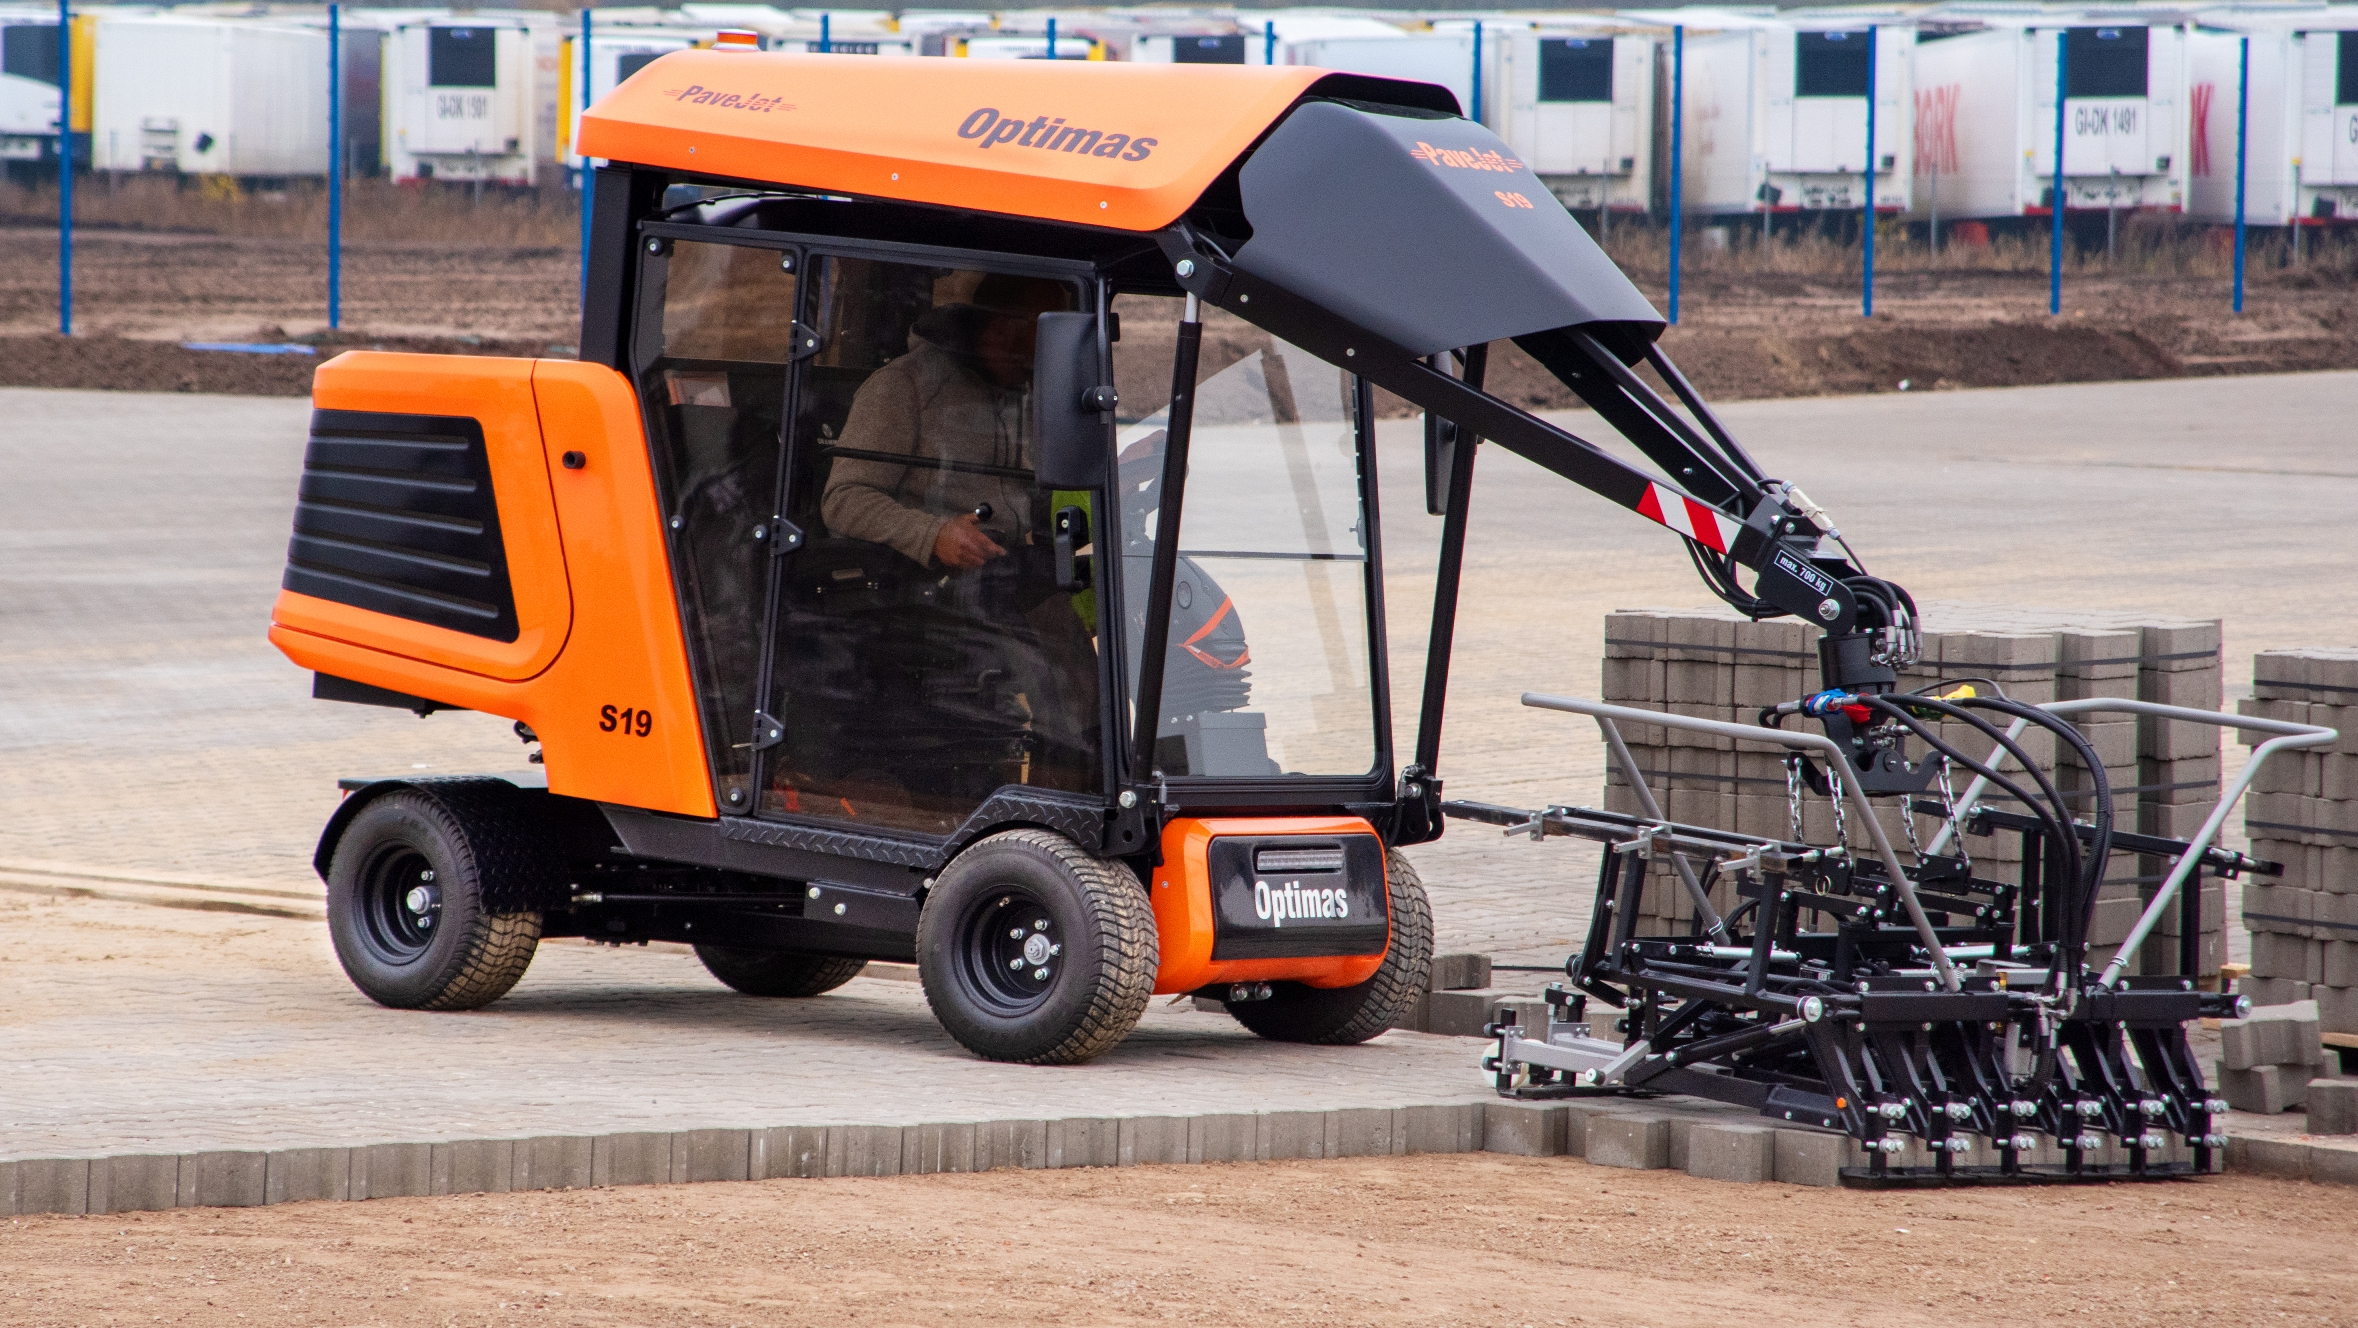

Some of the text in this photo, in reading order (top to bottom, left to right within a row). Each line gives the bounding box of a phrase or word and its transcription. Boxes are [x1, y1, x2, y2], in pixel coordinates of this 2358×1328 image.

[675, 84, 783, 113] PaveJet
[957, 107, 1158, 162] Optimas
[2075, 106, 2136, 136] GI-DK 1491
[1415, 141, 1515, 173] PaveJet
[1494, 190, 1534, 209] S19
[1780, 556, 1827, 592] max. 700 kg
[599, 704, 652, 738] S19
[1254, 880, 1349, 928] Optimas
